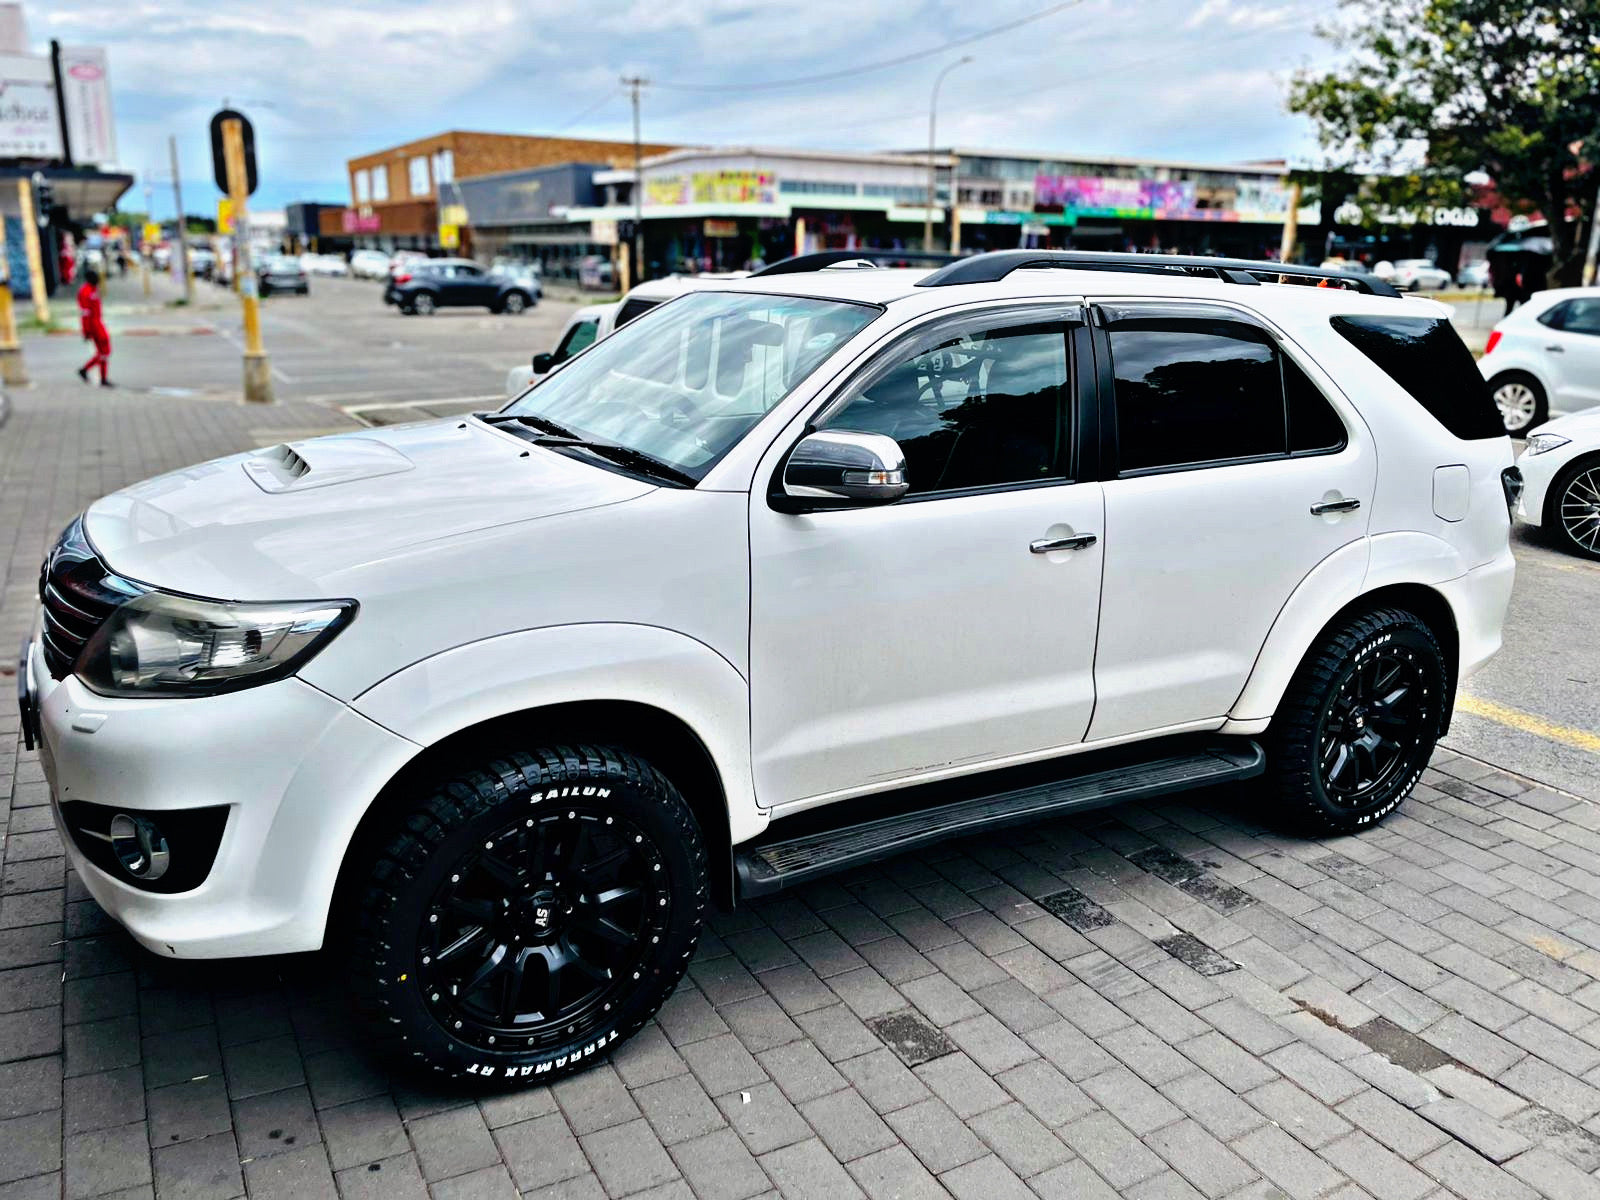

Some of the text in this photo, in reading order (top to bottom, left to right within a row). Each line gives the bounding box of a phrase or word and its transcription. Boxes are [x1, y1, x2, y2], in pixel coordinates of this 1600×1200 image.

[530, 786, 611, 804] SAILUN
[466, 1030, 619, 1077] TERRAMAX RT
